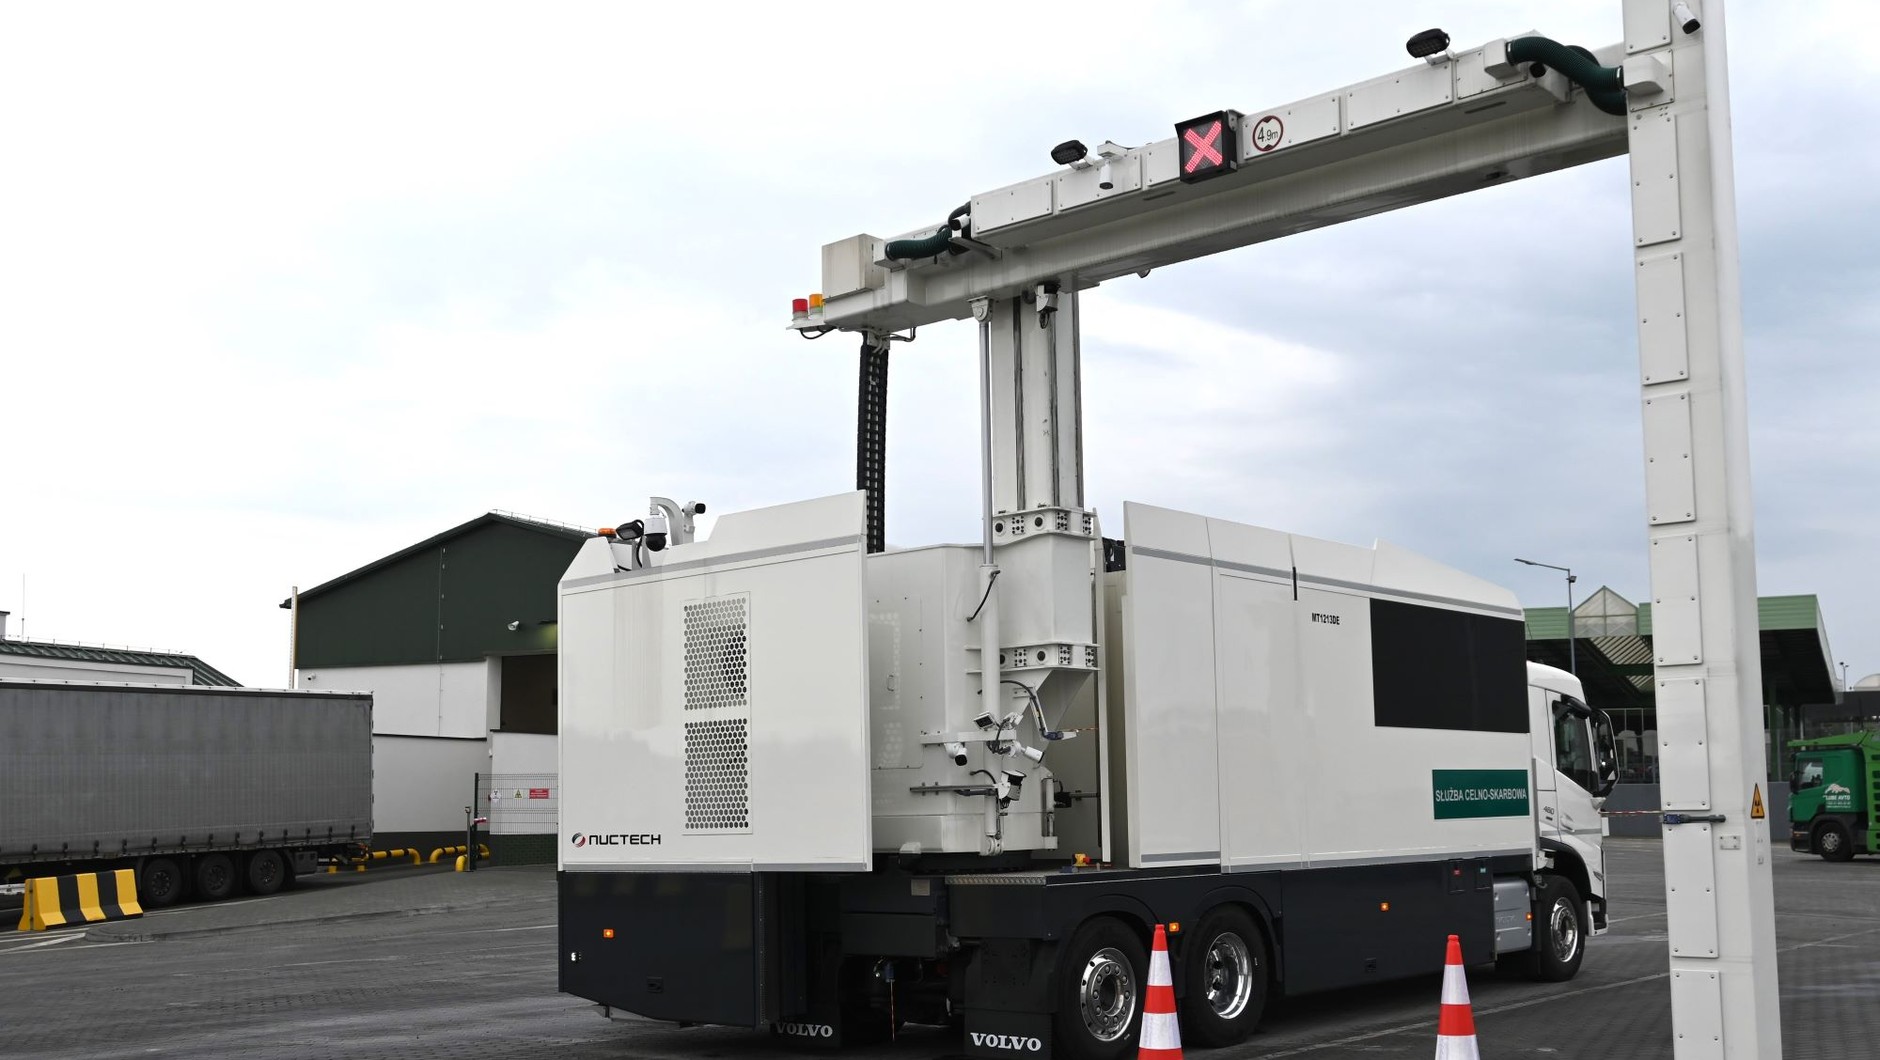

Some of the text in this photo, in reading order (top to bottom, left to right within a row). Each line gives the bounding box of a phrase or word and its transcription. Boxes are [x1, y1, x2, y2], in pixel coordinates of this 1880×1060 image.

[1257, 126, 1279, 143] 4.9m
[1435, 787, 1528, 802] SŁUŻBA CELNO-SKARBOWA
[588, 834, 662, 846] NUCTECH
[775, 1022, 833, 1038] VOLVO
[970, 1032, 1042, 1052] VOLVO
